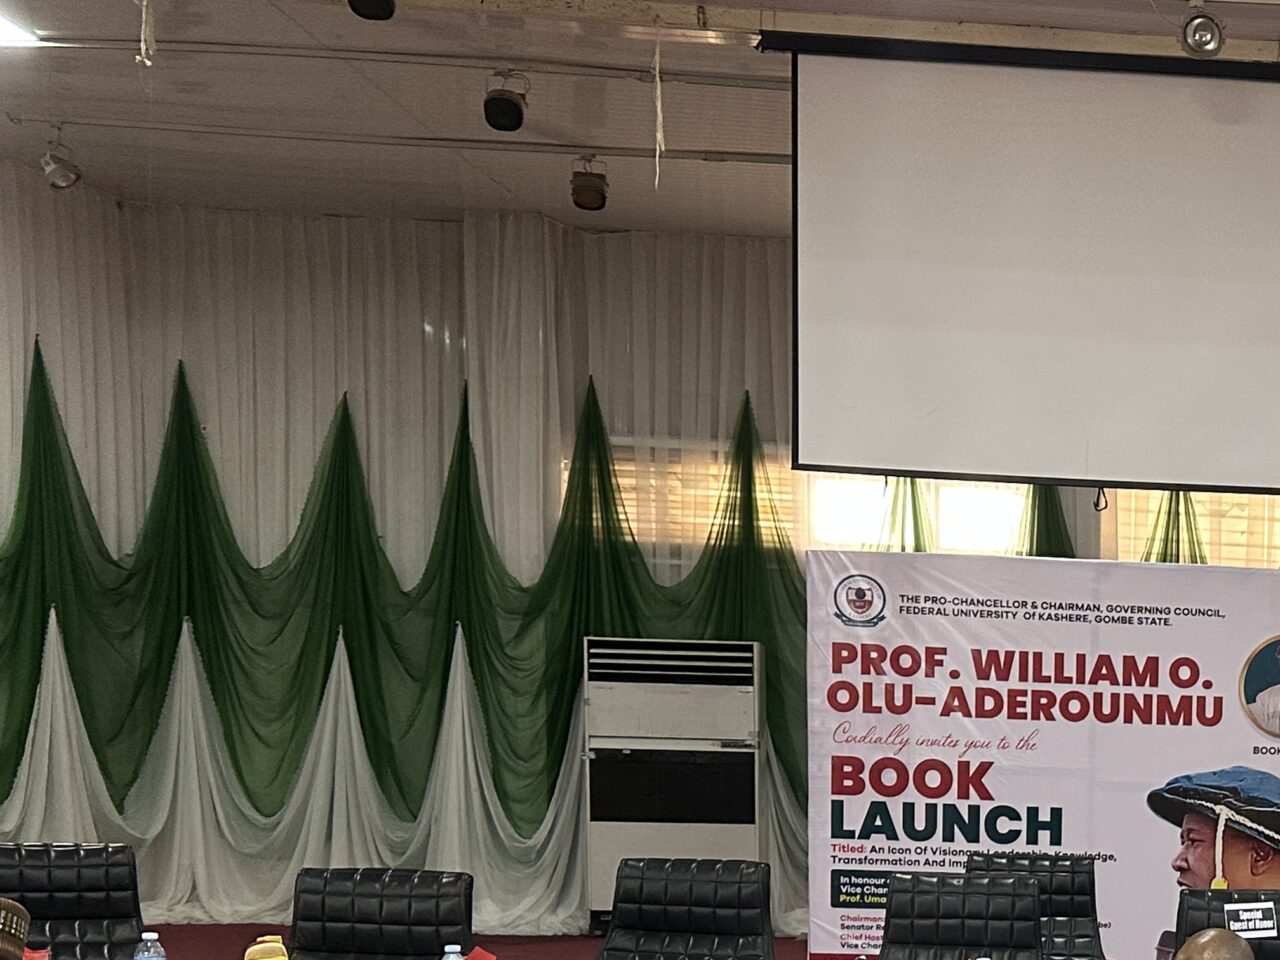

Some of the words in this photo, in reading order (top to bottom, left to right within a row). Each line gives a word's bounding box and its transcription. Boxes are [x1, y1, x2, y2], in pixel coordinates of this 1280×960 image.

[899, 594, 921, 604] THE
[923, 595, 1028, 610] PRO-CHANCELLOR
[1031, 601, 1038, 610] &
[1041, 601, 1103, 613] CHAIRMAN,
[1105, 604, 1171, 616] GOVERNING
[1174, 607, 1226, 619] COUNCIL,
[899, 606, 949, 618] FEDERAL
[952, 609, 1018, 621] UNIVERSITY
[1038, 613, 1092, 625] KASHERE,
[1095, 615, 1134, 626] GOMBE
[1137, 616, 1173, 627] STATE.
[831, 642, 960, 680] PROF.
[970, 648, 1159, 688] WILLIAM
[1168, 657, 1213, 690] O.
[826, 680, 1223, 727] OLU-ADEROUNMU
[832, 720, 911, 755] Cordially
[915, 731, 959, 748] invites
[964, 737, 991, 759] you
[997, 736, 1010, 750] to
[1015, 729, 1039, 752] the
[831, 756, 994, 801] BOOK
[831, 800, 1062, 846] LAUNCH
[831, 843, 867, 854] Titled:
[870, 845, 886, 855] An
[888, 846, 911, 856] Icon
[914, 846, 927, 856] Of
[831, 855, 920, 867] Transformation
[923, 857, 945, 868] And
[949, 858, 968, 869] Imp
[841, 876, 850, 884] In
[851, 876, 885, 885] honour
[841, 886, 861, 894] Vice
[864, 886, 888, 894] Chan
[840, 895, 862, 903] Prof.
[865, 895, 887, 903] Uma
[1239, 910, 1263, 920] Special
[1230, 920, 1248, 930] Guest
[840, 933, 862, 941] Chief
